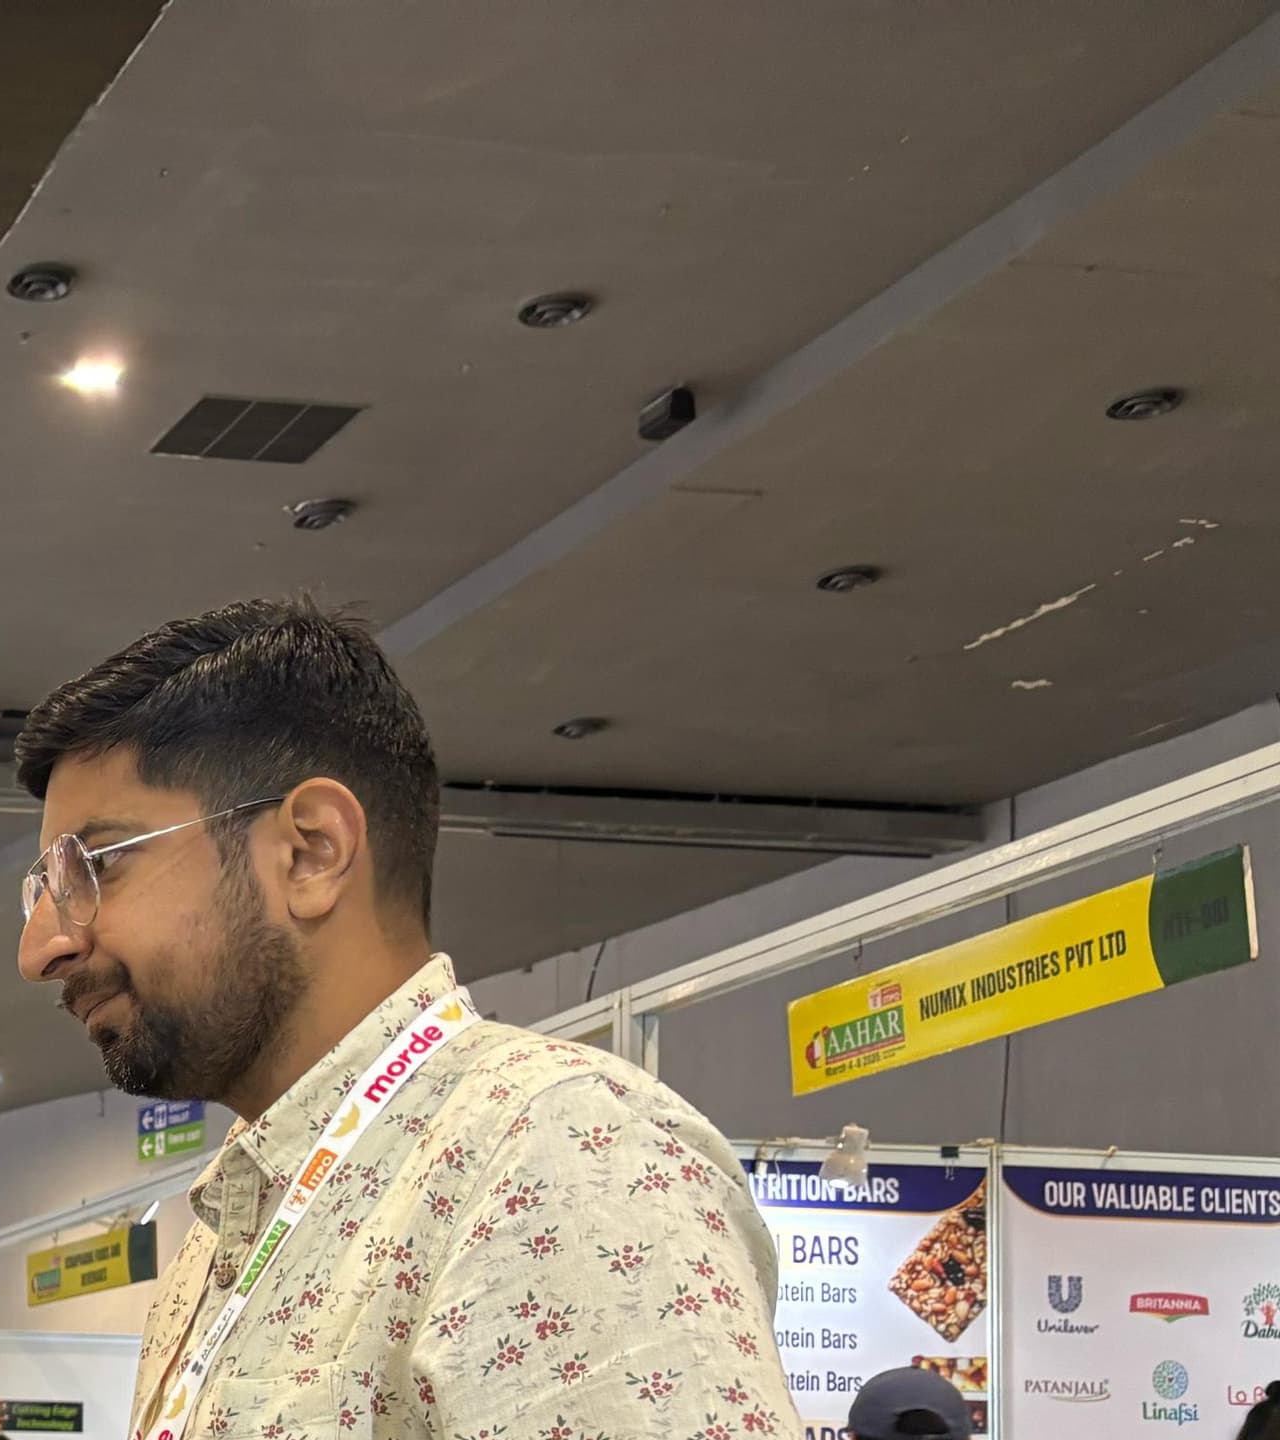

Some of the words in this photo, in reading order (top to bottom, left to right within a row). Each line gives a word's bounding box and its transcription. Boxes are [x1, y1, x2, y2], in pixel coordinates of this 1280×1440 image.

[919, 985, 968, 1021] NUMIX
[971, 951, 1061, 1002] INDUSTRIES
[1065, 942, 1094, 974] PVT
[1099, 930, 1127, 962] LTD
[826, 1010, 902, 1057] AAHAR
[364, 1026, 443, 1104] morde
[308, 1155, 333, 1188] ITPO
[750, 1172, 838, 1203] TRITION
[846, 1177, 900, 1204] BARS
[1044, 1180, 1086, 1209] OUR
[1092, 1182, 1196, 1214] VALUABLE
[1201, 1185, 1280, 1217] CLIENTS
[792, 1234, 860, 1266] BARS
[820, 1282, 858, 1304] Bars
[1136, 1296, 1202, 1313] BRITANNIA
[821, 1328, 858, 1350] Bars
[1037, 1317, 1100, 1335] Unilever
[786, 1371, 820, 1392] tein
[826, 1371, 864, 1393] Bars
[1142, 1401, 1200, 1426] Linafsi
